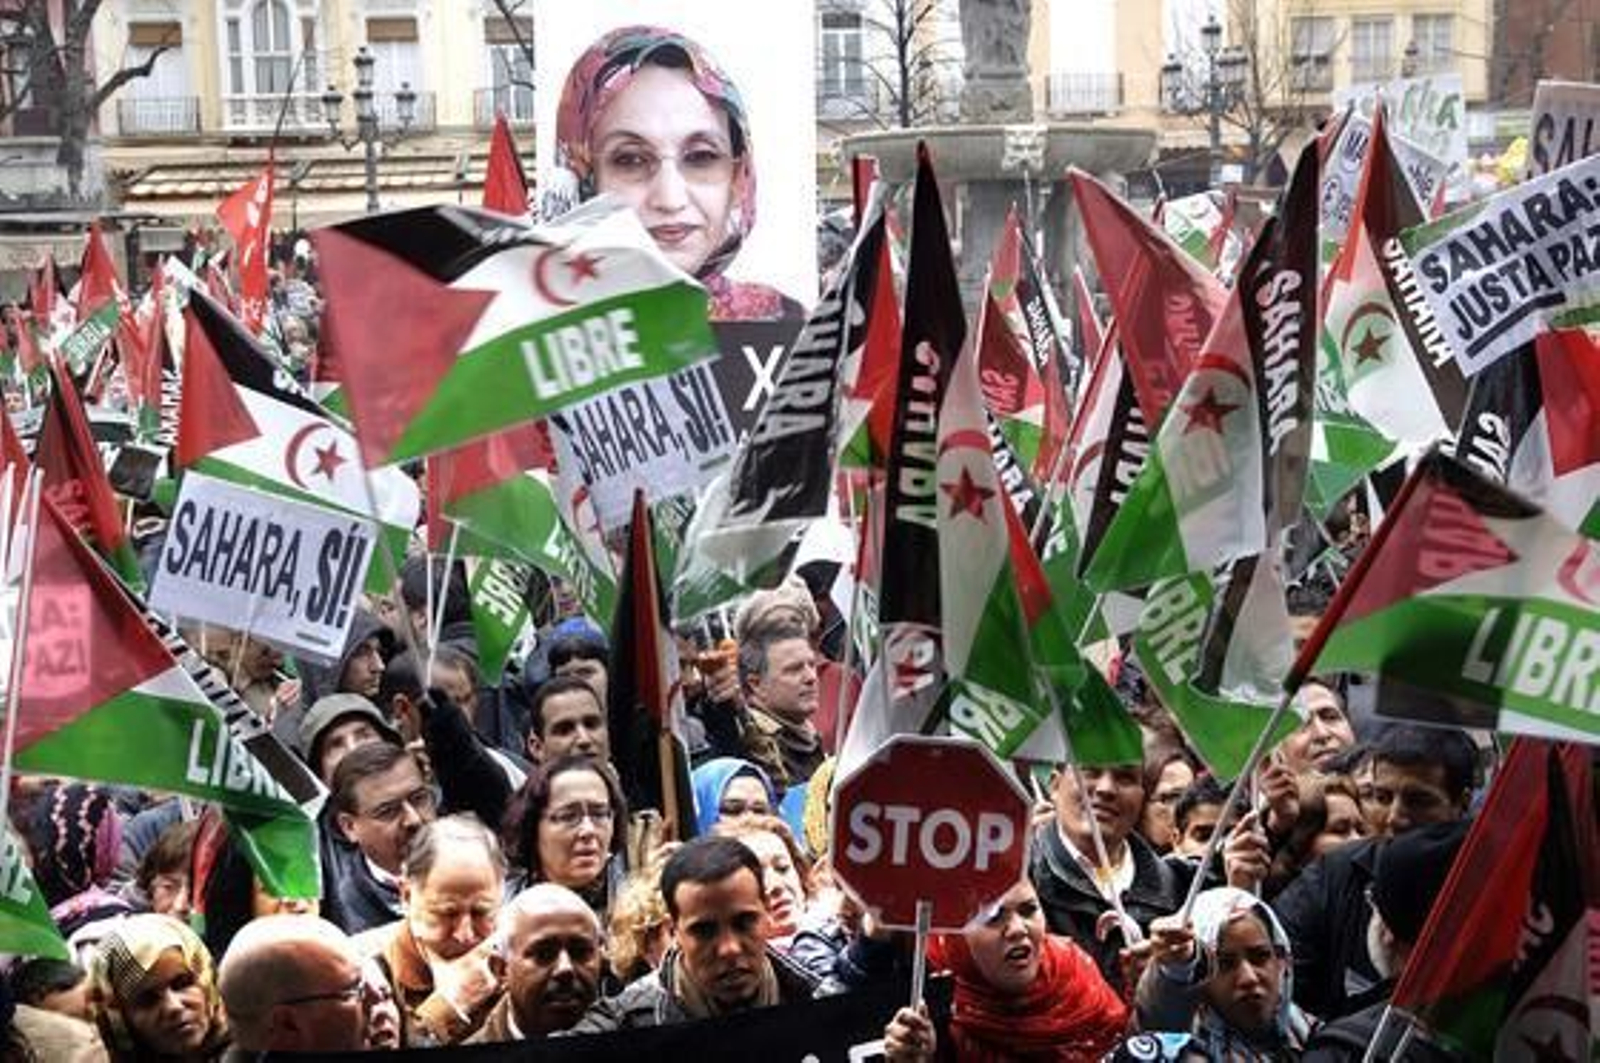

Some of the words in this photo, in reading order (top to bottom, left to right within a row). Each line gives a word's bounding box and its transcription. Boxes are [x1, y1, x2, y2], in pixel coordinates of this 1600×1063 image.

[1421, 177, 1600, 294] SAHARA:
[1451, 253, 1554, 340] JUSTA
[521, 308, 646, 400] LIBRE
[740, 344, 785, 411] X
[1256, 268, 1302, 457] SAHARA
[166, 499, 303, 618] SAHARA,
[305, 522, 368, 629] SÍ!
[845, 801, 1014, 872] STOP
